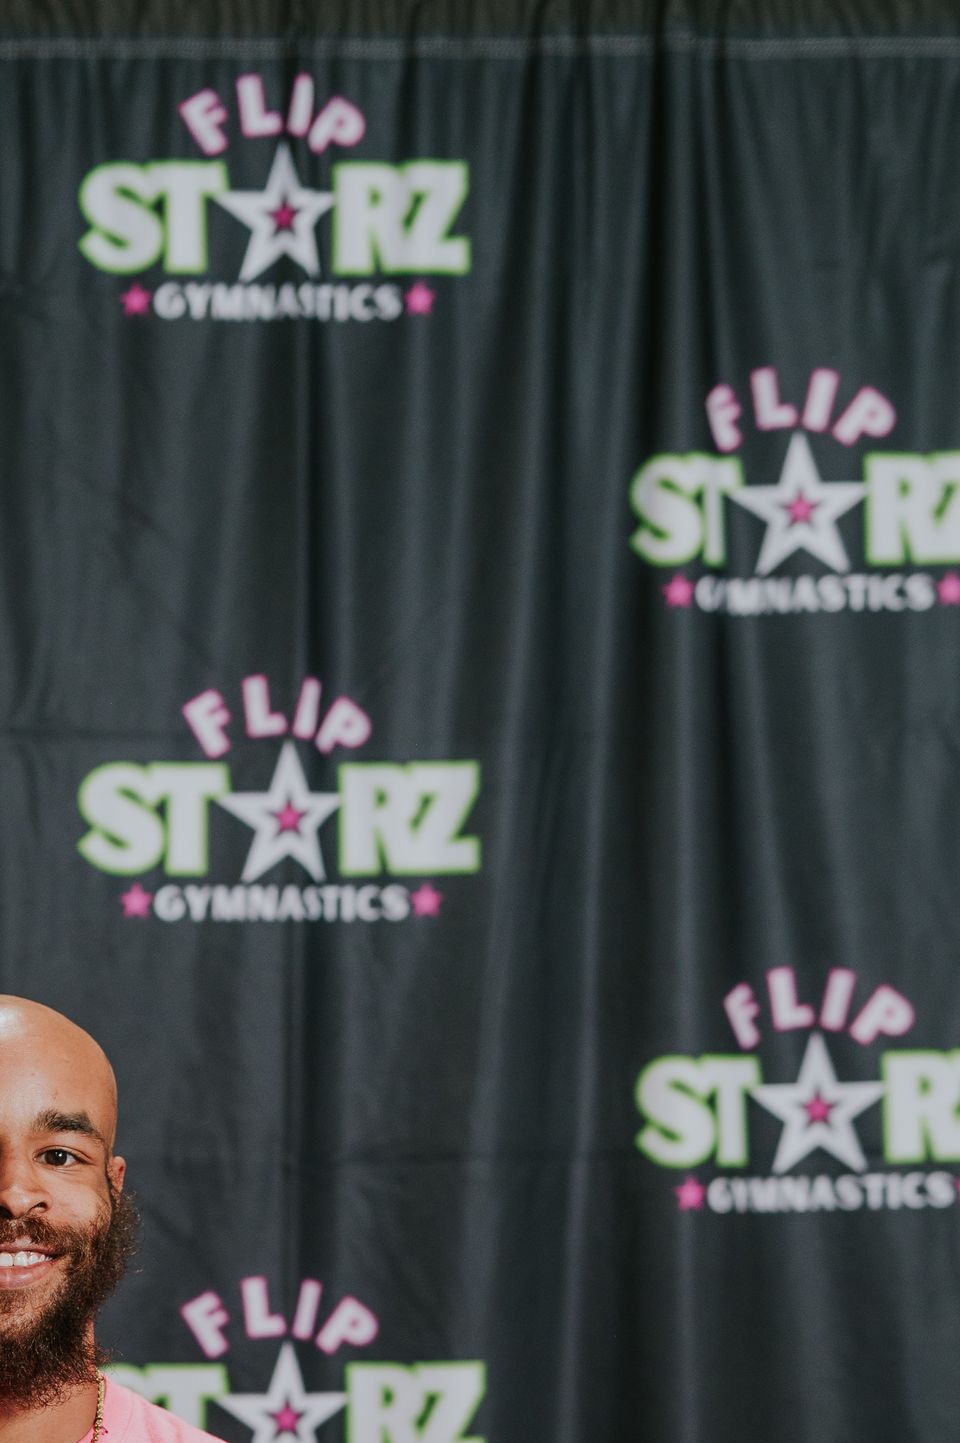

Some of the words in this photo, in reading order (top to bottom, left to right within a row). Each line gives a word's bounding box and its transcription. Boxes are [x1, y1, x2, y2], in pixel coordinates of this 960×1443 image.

[178, 73, 367, 157] FLIP
[152, 280, 403, 322] GYMNASTICS
[706, 367, 897, 452] FLIP
[181, 673, 373, 759] FLIP
[152, 883, 411, 923] GYMNASTICS
[723, 965, 916, 1050] FLIP
[180, 1275, 379, 1358] FLIP
